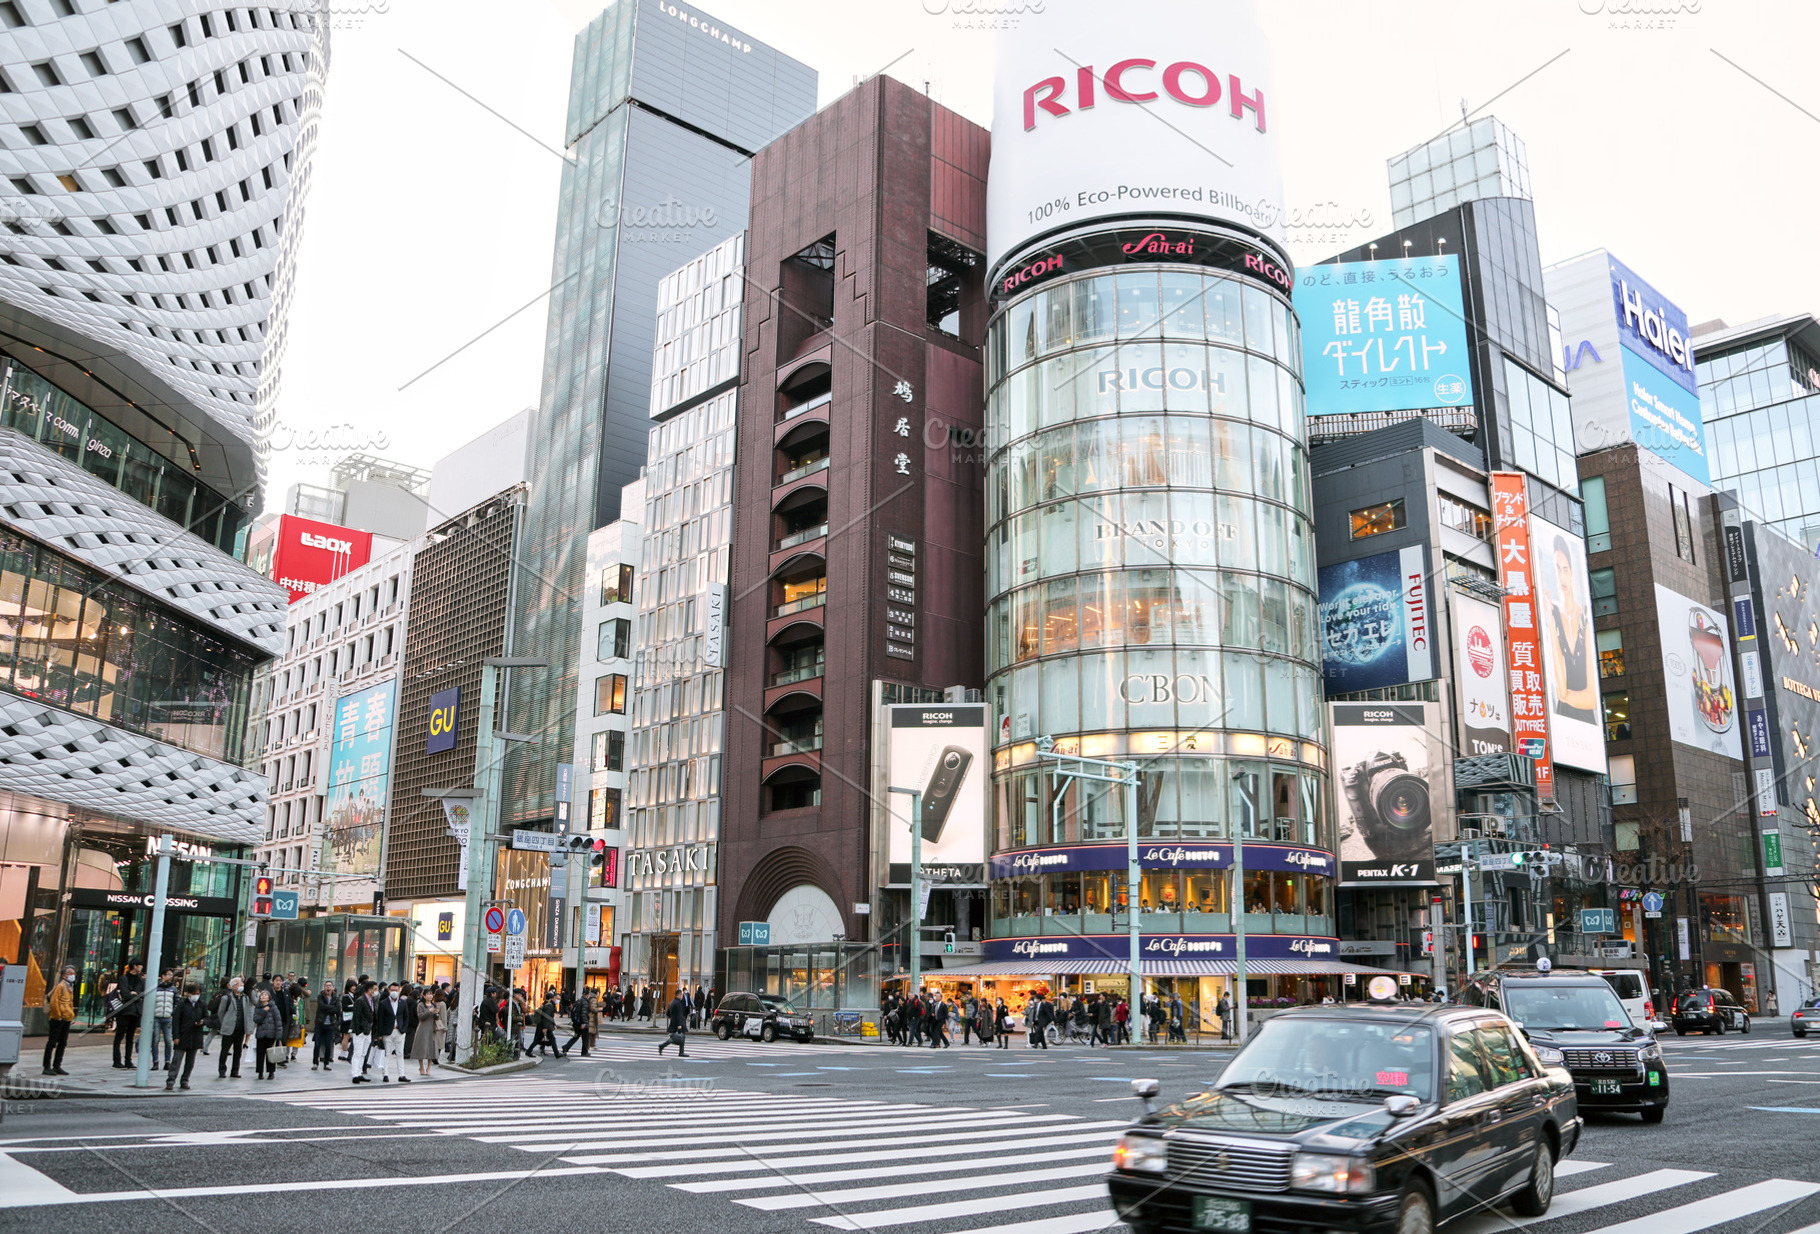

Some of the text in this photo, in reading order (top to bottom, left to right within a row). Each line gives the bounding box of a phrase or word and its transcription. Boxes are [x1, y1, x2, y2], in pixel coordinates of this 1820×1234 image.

[660, 1, 752, 54] LONGCHAMP
[1023, 58, 1267, 133] RICOH
[1027, 185, 1273, 225] 100% Eco-Powered Billboard
[1122, 233, 1194, 256] San-ai
[1003, 254, 1063, 293] RICOH
[1303, 265, 1449, 287] のど、直接、うるおう
[1332, 293, 1427, 335] 龍角散
[1619, 279, 1693, 372] Haier
[1322, 335, 1448, 377] ダイレクト
[1097, 367, 1226, 395] RICOH
[1340, 377, 1388, 390] スティック
[892, 381, 914, 476] 鳩居堂
[1494, 490, 1524, 505] ブランド
[1497, 513, 1527, 529] チケット
[1505, 505, 1514, 515] &
[1096, 519, 1187, 541] BRAND
[1501, 538, 1534, 629] 大黒屋
[1405, 573, 1427, 652] FUJITEC
[707, 592, 721, 658] TASAKI
[1511, 642, 1535, 668] 質
[1119, 673, 1224, 705] C'BON
[1511, 670, 1541, 692] 買取
[1782, 676, 1813, 700] BOTTEGA
[922, 712, 953, 720] RICOH
[1363, 710, 1394, 719] RICOH
[1513, 694, 1544, 717] 販売
[338, 690, 388, 753] 青春
[430, 704, 455, 737] GU
[1535, 766, 1549, 779] 1F
[147, 836, 212, 865] NSSAN
[516, 834, 555, 846] 銀座四丁目
[628, 846, 709, 877] TASAKI
[926, 868, 961, 877] THETA
[1357, 864, 1419, 877] PENTAX K-1
[107, 894, 199, 908] NISSAN COSSING
[438, 919, 451, 934] GU
[1598, 1084, 1620, 1094] 11-54
